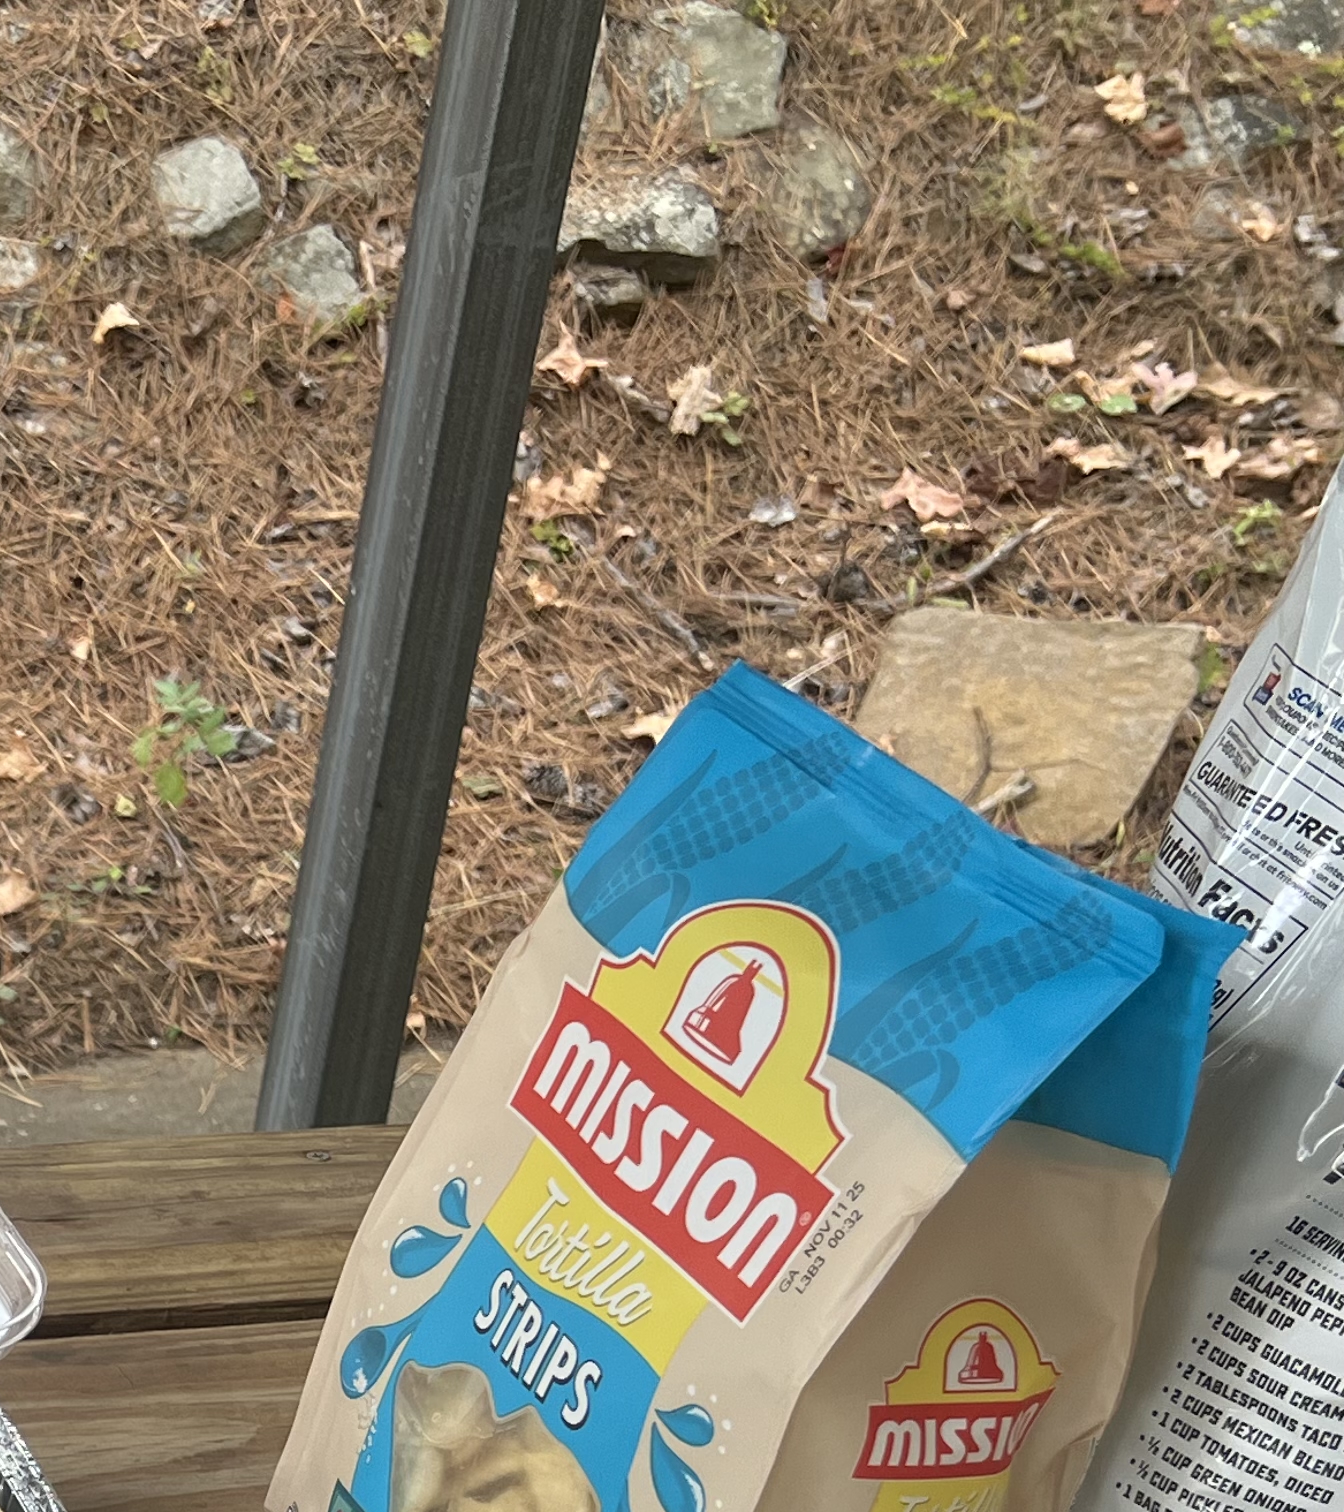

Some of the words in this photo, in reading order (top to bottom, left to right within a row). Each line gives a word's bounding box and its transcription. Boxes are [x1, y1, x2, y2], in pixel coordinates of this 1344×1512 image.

[1283, 810, 1344, 857] FRES
[533, 1021, 798, 1288] MISSION
[515, 1177, 653, 1327] Tortilla
[779, 1270, 800, 1293] GA
[804, 1219, 831, 1258] NOV
[832, 1202, 848, 1218] 11
[846, 1181, 865, 1202] 25
[1285, 1215, 1309, 1236] 16
[1230, 1286, 1268, 1318] BEAN
[1266, 1308, 1295, 1331] DIP
[1238, 1268, 1312, 1317] JALAPENO
[1310, 1307, 1344, 1336] PEP
[1284, 1266, 1308, 1289] OZ
[473, 1269, 603, 1430] STRIPS
[1207, 1346, 1247, 1378] CUPS
[1246, 1368, 1288, 1400] SOUR
[1289, 1391, 1344, 1422] CREAM
[1221, 1321, 1261, 1353] CUPS
[1260, 1343, 1344, 1398] GUACAMOL
[1181, 1395, 1223, 1425] CUPS
[1221, 1416, 1293, 1460] MEXICAN
[1195, 1370, 1298, 1433] TABLESPOONS
[1300, 1424, 1343, 1451] TACO
[1149, 1470, 1179, 1496] CUP
[1161, 1446, 1193, 1471] CUP
[1190, 1463, 1243, 1498] GREEN
[1170, 1418, 1201, 1442] CUP
[1200, 1434, 1280, 1487] TOMATOES,
[1283, 1476, 1335, 1505] DICED
